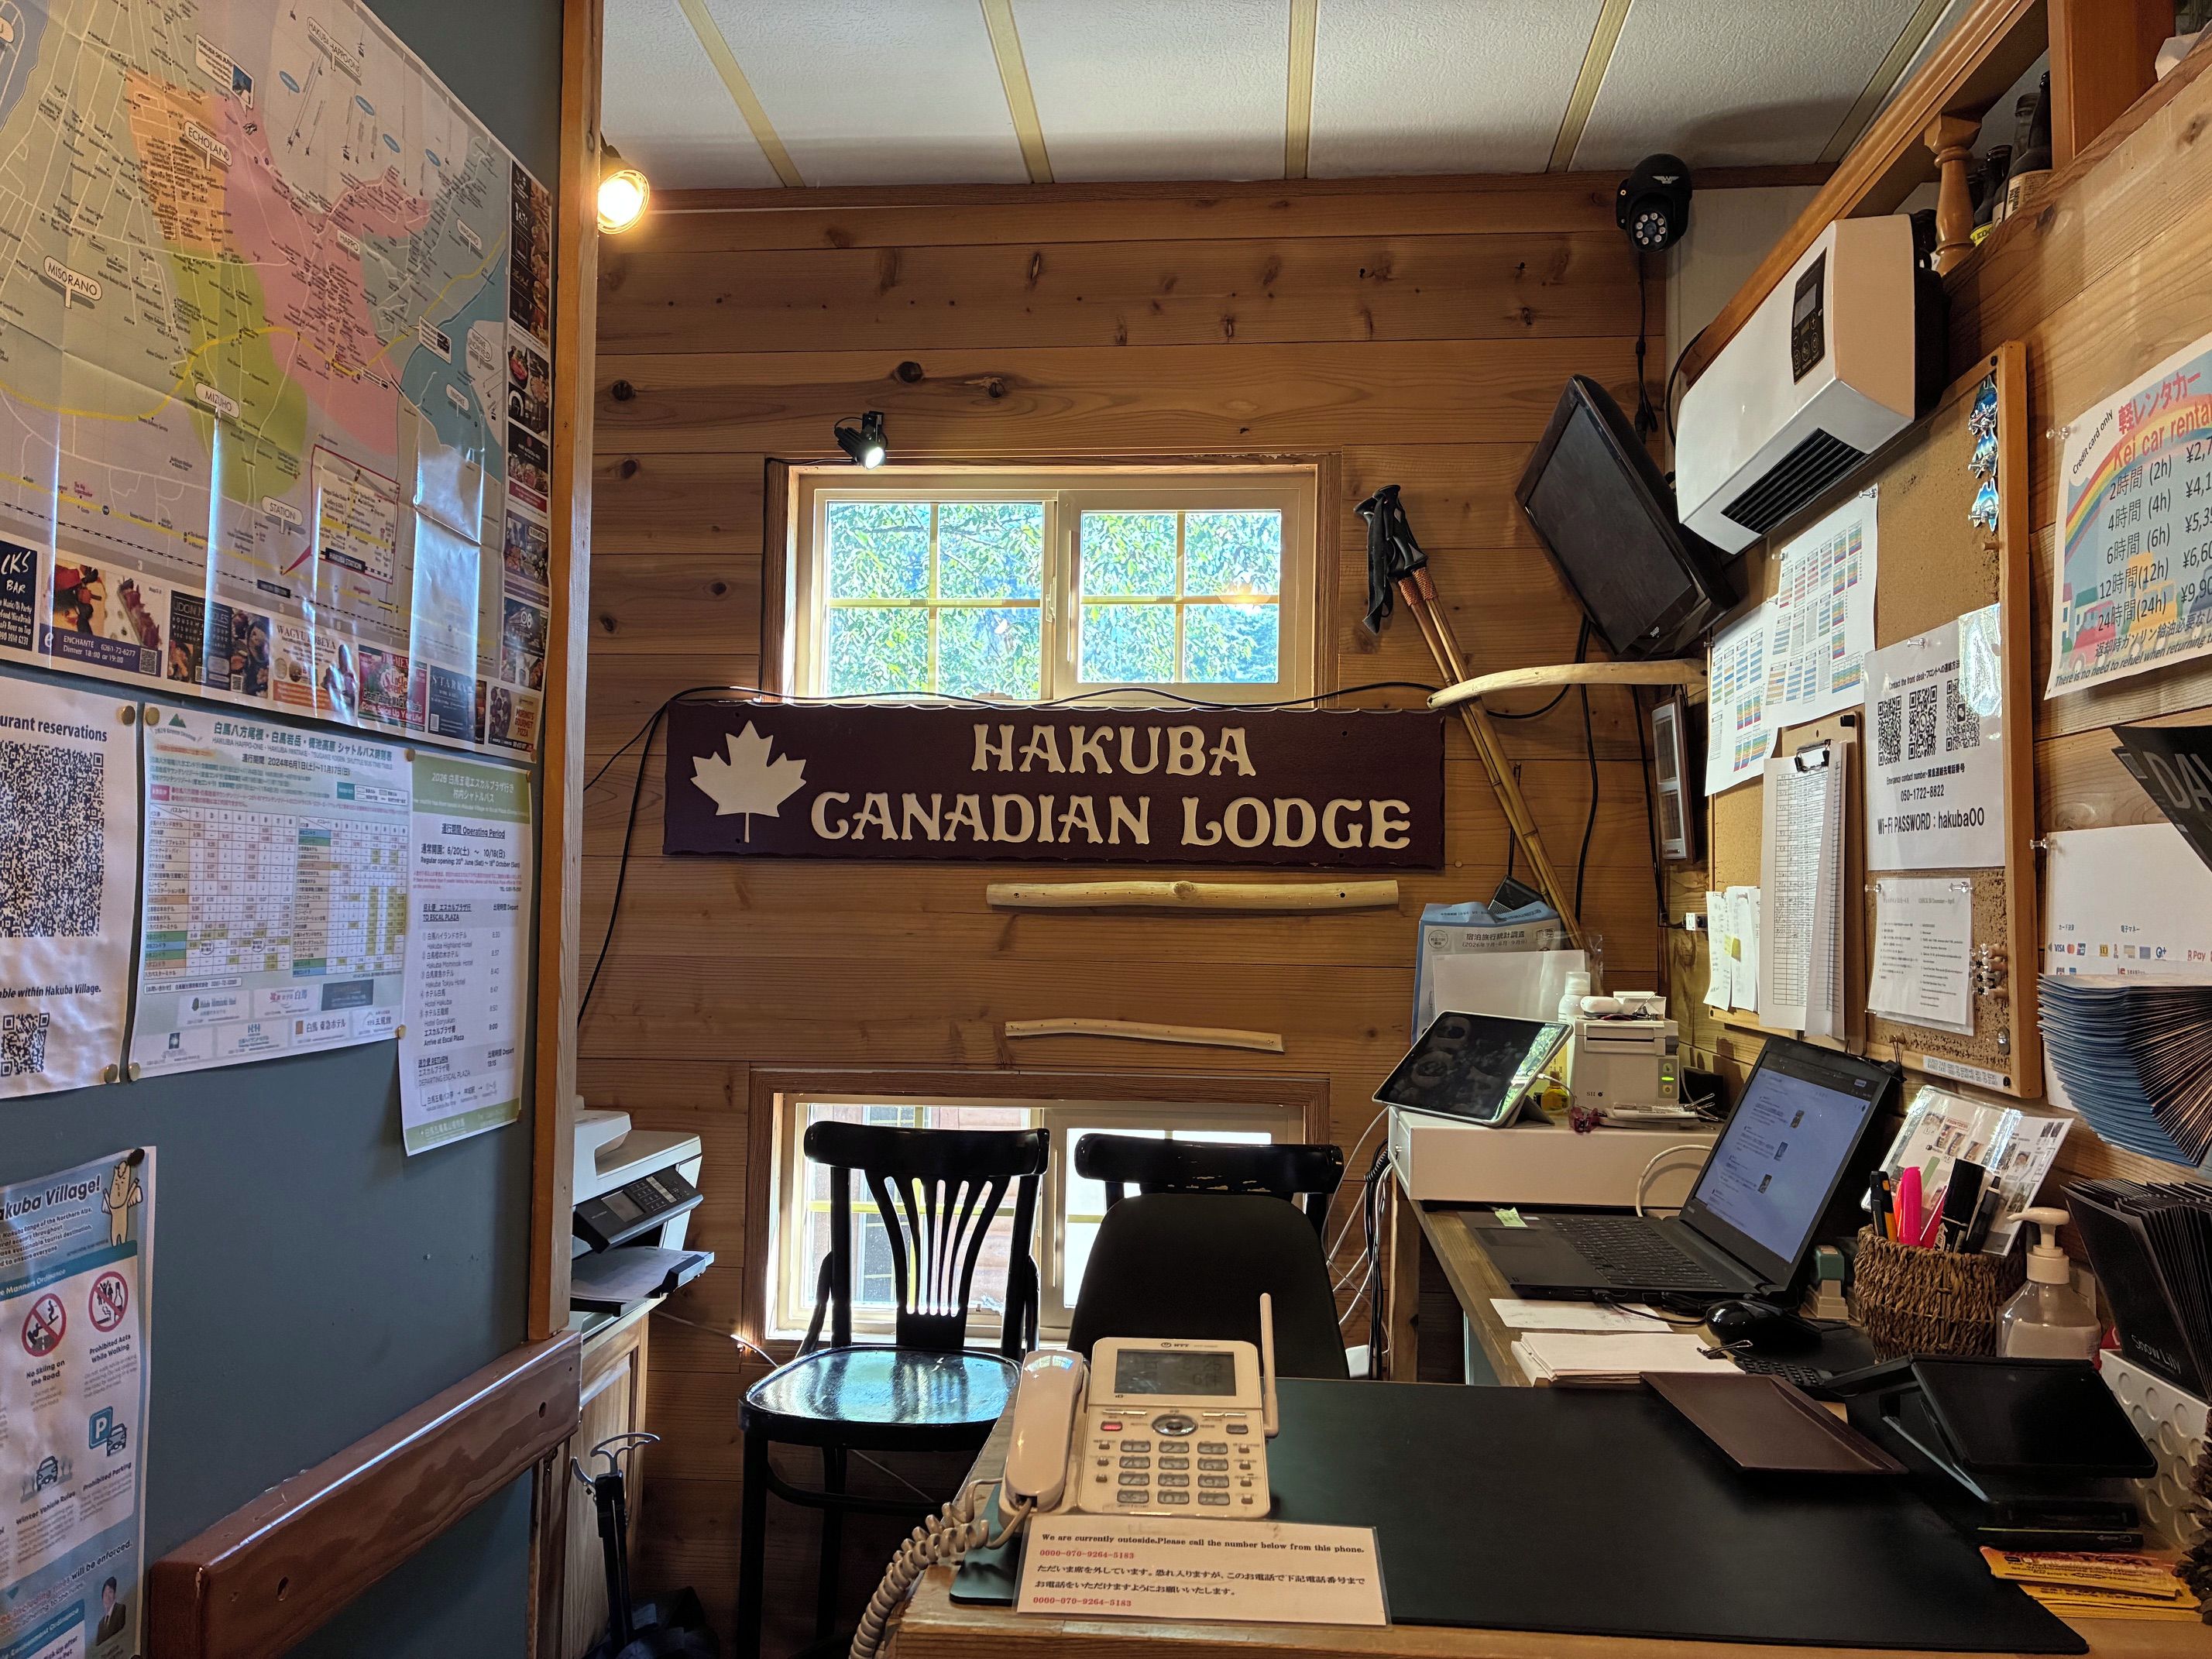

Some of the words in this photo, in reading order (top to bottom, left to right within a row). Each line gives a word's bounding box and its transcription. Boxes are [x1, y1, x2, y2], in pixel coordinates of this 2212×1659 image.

[187, 126, 231, 161] ECHOLAND
[47, 262, 98, 297] MISORANO
[204, 390, 233, 413] MIZUHO
[2118, 371, 2201, 435] 軽レンタカー
[2072, 447, 2090, 476] Credit
[2088, 428, 2101, 451] card
[2100, 408, 2114, 432] only
[2113, 436, 2137, 472] Kei
[2142, 425, 2165, 457] car
[2110, 465, 2144, 501] 2時間
[2148, 454, 2172, 487] (2h)
[270, 502, 296, 520] STATION
[2107, 499, 2142, 531] 4時間
[2148, 487, 2172, 520] (4h)
[2107, 531, 2140, 565] 6時間
[2147, 523, 2171, 553] (6h)
[2185, 506, 2212, 534] ¥5,3
[6, 579, 26, 594] BAR
[2055, 672, 2075, 688] There
[2073, 670, 2080, 682] is
[2080, 668, 2091, 679] no
[2090, 661, 2110, 678] need
[2110, 659, 2119, 672] to
[2119, 651, 2143, 670] refuel
[2143, 647, 2166, 665] when
[2166, 637, 2208, 658] returning
[37, 720, 108, 743] reservations
[971, 723, 1257, 778] HAKUBA
[1900, 784, 1945, 802] 050-1722-8822
[810, 790, 1151, 847] CANADIAN
[1180, 795, 1412, 850] LODGE
[1877, 817, 1894, 835] Wi-Fi
[1894, 812, 1932, 833] PASSWORD
[462, 826, 489, 837] Operating
[489, 829, 506, 839] Period
[1465, 929, 1526, 941] 宿泊旅行統計調査
[2054, 943, 2066, 953] VISA
[17, 986, 44, 998] within
[45, 984, 73, 996] Hakuba
[74, 983, 101, 996] Village.
[45, 1175, 101, 1207] Village!
[55, 1359, 66, 1368] on
[1042, 1533, 1055, 1541] We
[1074, 1534, 1115, 1544] currently
[1189, 1538, 1204, 1547] call
[1207, 1538, 1222, 1547] the
[1224, 1540, 1259, 1549] number
[1261, 1541, 1287, 1551] below
[1290, 1542, 1312, 1551] from
[1314, 1544, 1331, 1552] this
[1334, 1544, 1365, 1554] phone.
[71, 1566, 85, 1581] will
[85, 1561, 96, 1573] be
